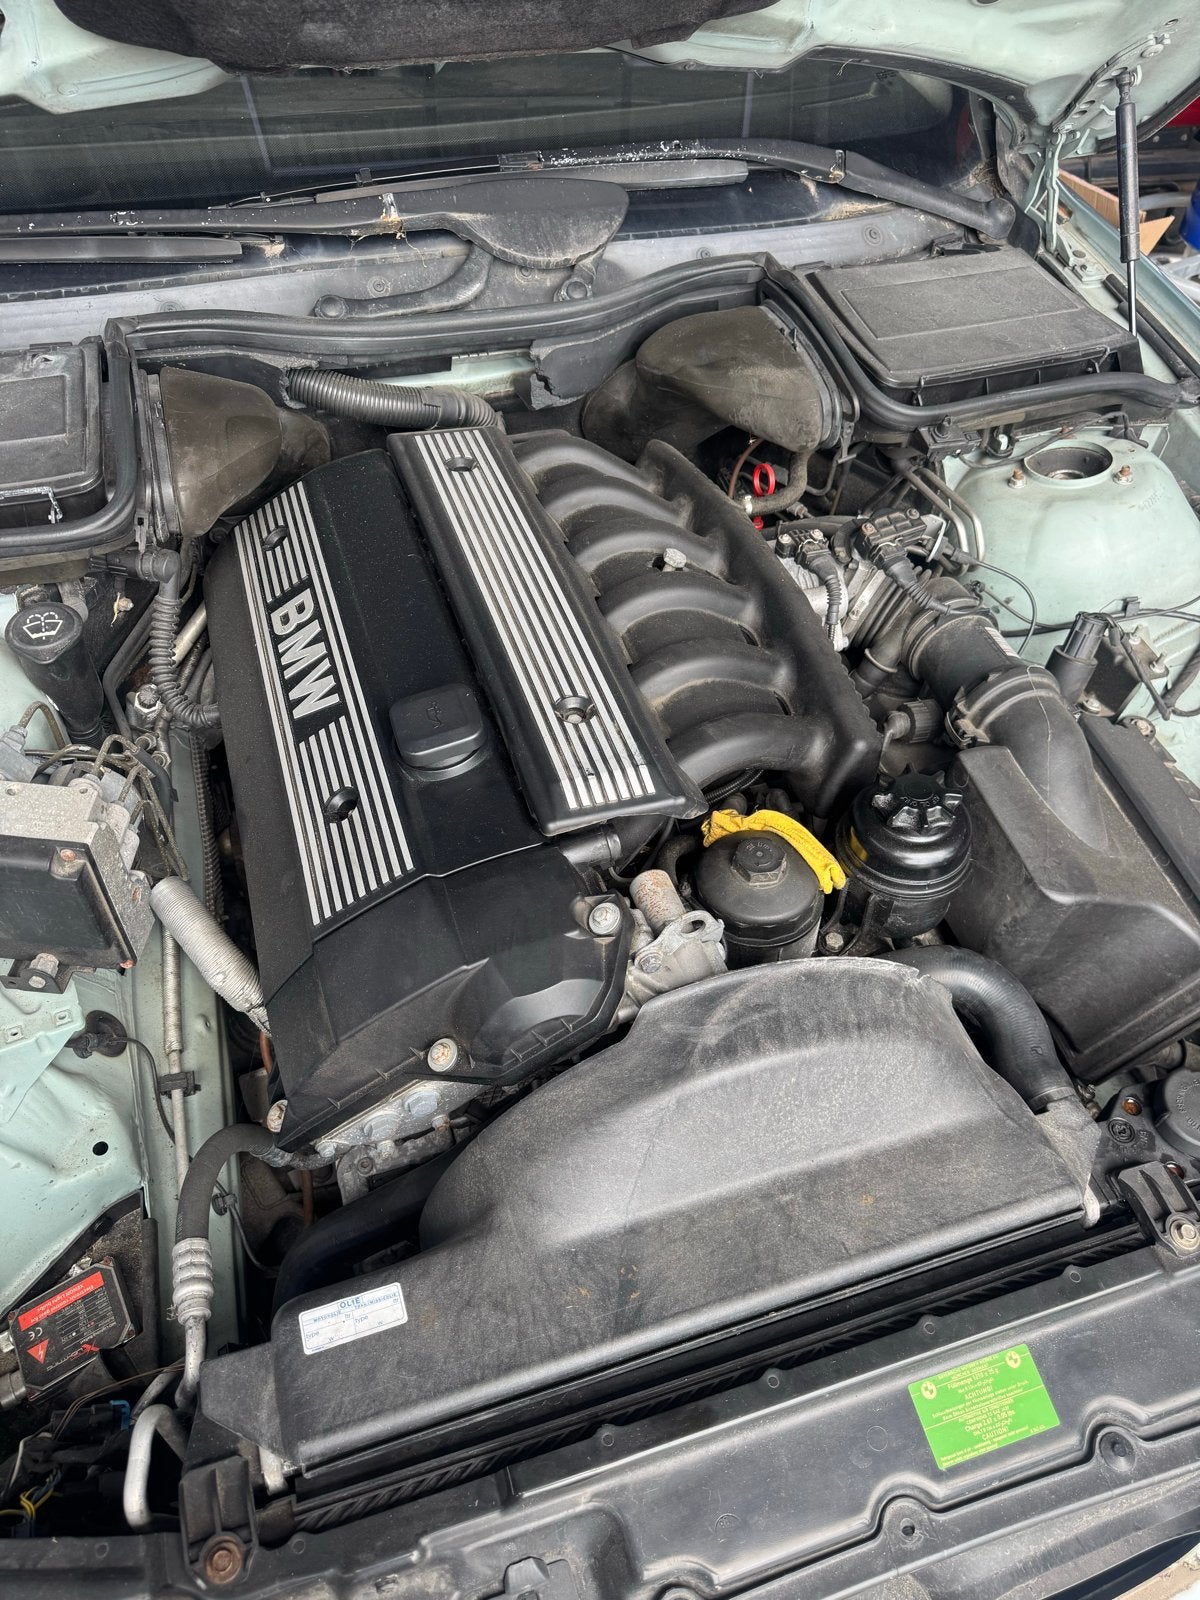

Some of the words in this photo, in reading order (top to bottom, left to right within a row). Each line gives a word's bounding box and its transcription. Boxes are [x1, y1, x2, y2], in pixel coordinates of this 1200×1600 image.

[270, 588, 341, 719] BMW
[340, 1297, 361, 1309] OLIE
[964, 1385, 994, 1400] ACHTUNG!
[982, 1426, 1009, 1440] CAUTION!
